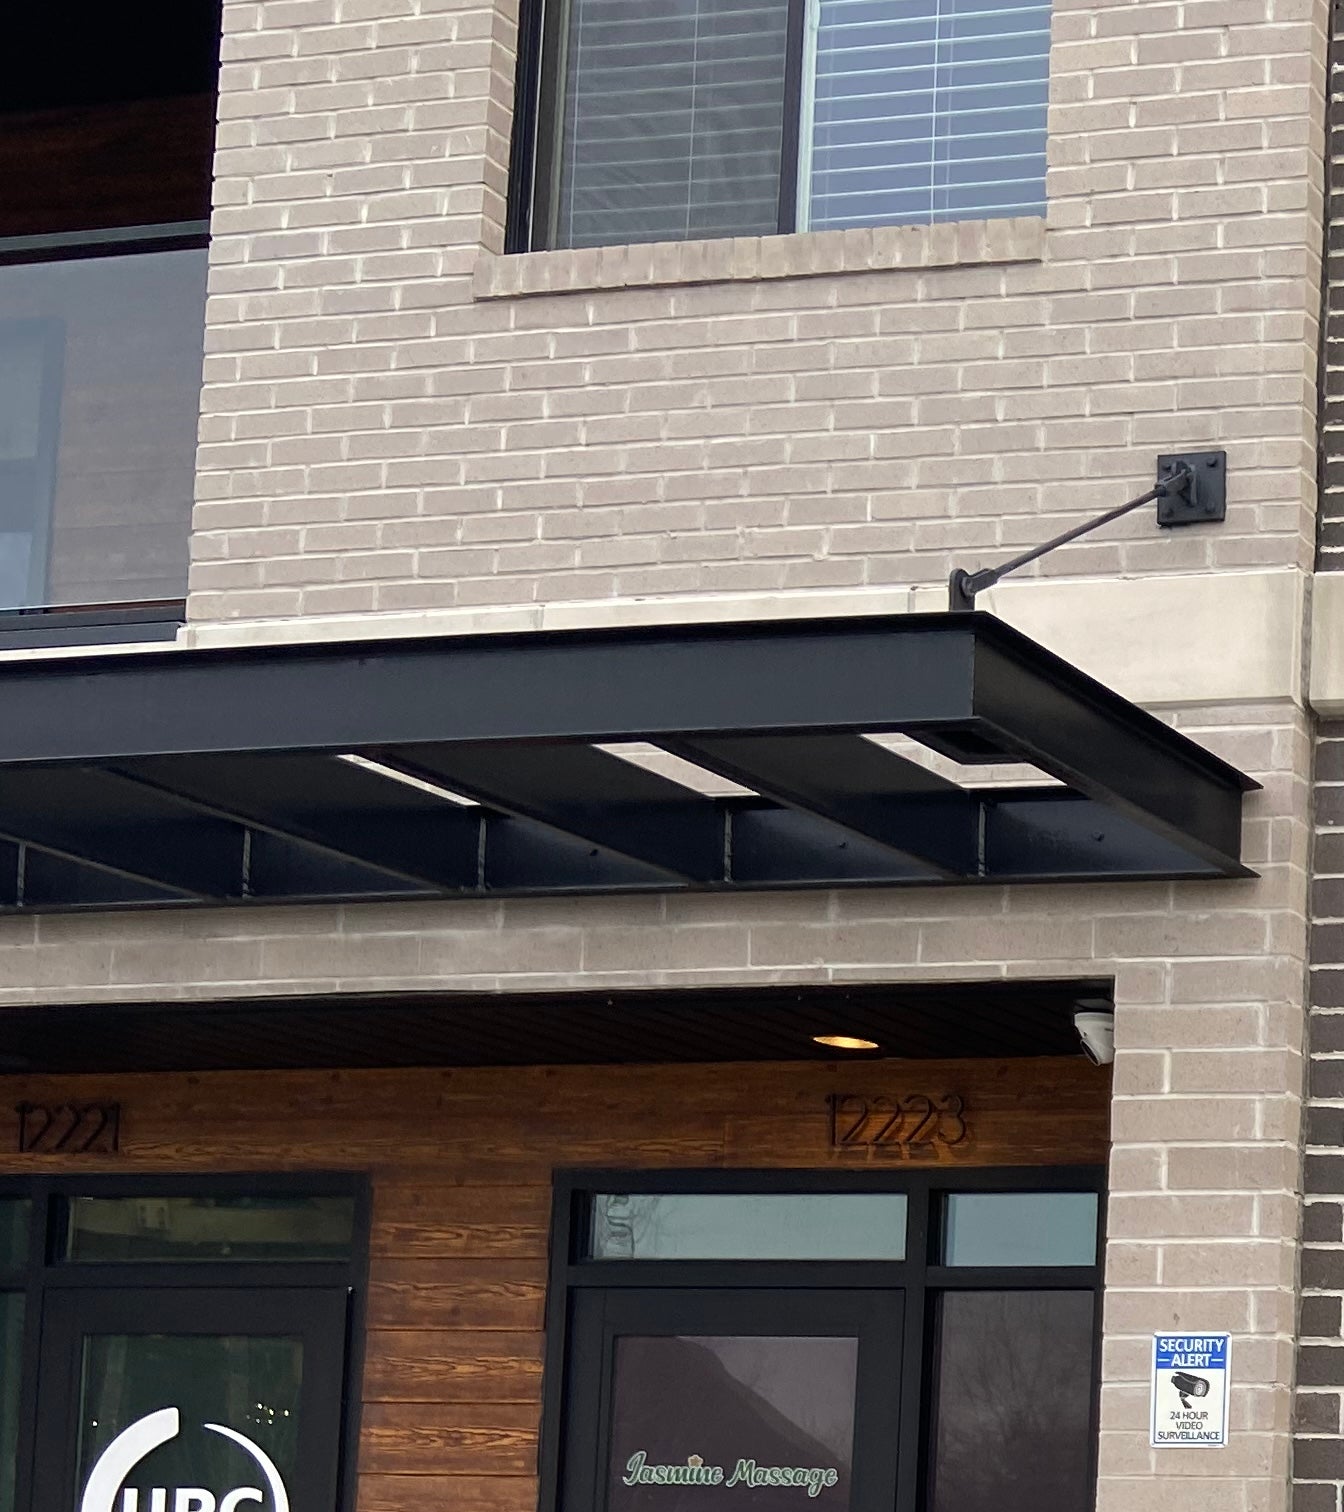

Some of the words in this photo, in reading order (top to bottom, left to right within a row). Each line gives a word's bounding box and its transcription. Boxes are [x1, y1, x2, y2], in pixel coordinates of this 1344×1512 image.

[16, 1100, 120, 1153] 12221
[827, 1093, 967, 1146] 12223
[1159, 1338, 1225, 1353] SECURITY
[1170, 1353, 1212, 1367] ALERT
[1170, 1411, 1181, 1420] 24
[1182, 1411, 1209, 1420] HOUR
[1175, 1421, 1203, 1430] VIDEO
[1157, 1431, 1220, 1440] SURVEILLANCE
[622, 1450, 725, 1487] Jasmine
[725, 1458, 839, 1498] Massage
